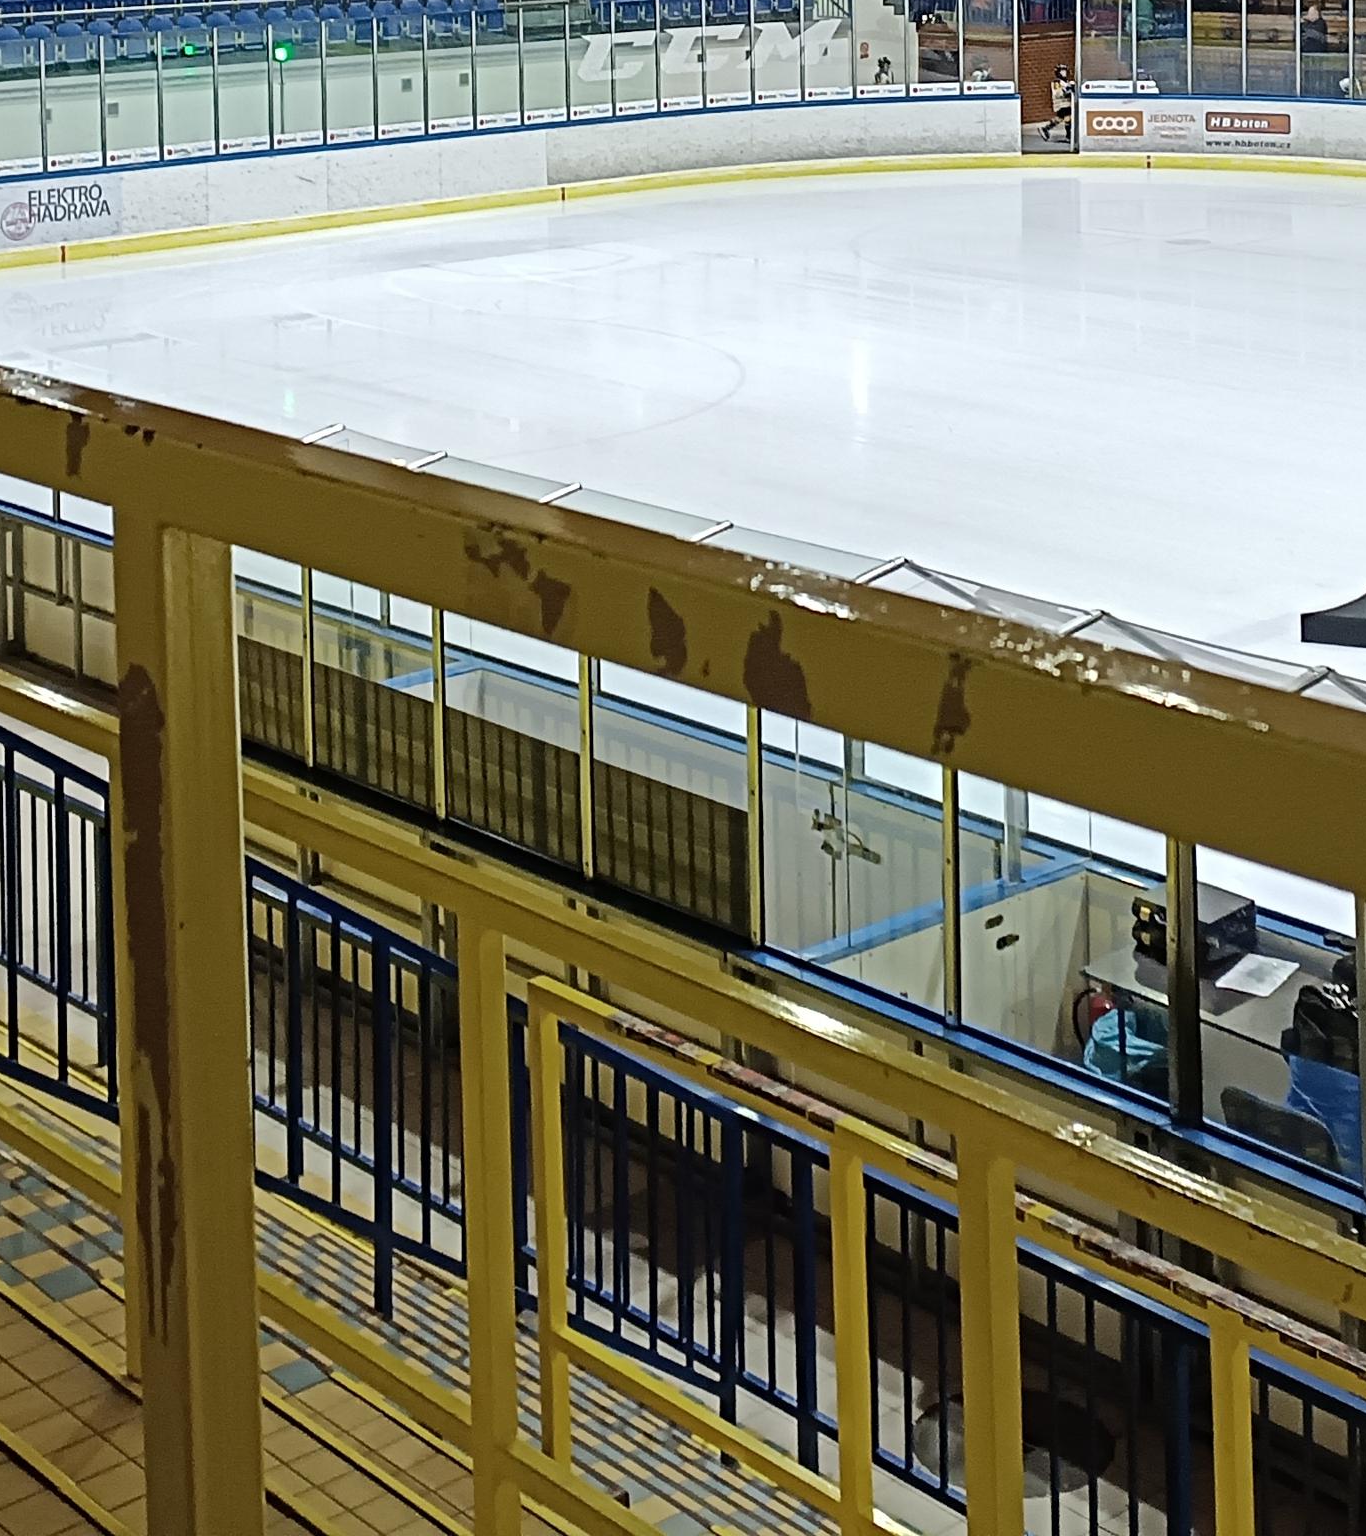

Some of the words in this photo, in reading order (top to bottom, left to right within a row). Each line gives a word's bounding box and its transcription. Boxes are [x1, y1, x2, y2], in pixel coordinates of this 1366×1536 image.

[577, 18, 842, 82] CCM
[1092, 116, 1138, 133] coop
[1147, 114, 1196, 124] JEDNOTA
[1210, 116, 1232, 128] HB
[1233, 118, 1270, 129] beton
[28, 183, 103, 208] ELEKTRO
[28, 199, 112, 224] HADRAVA
